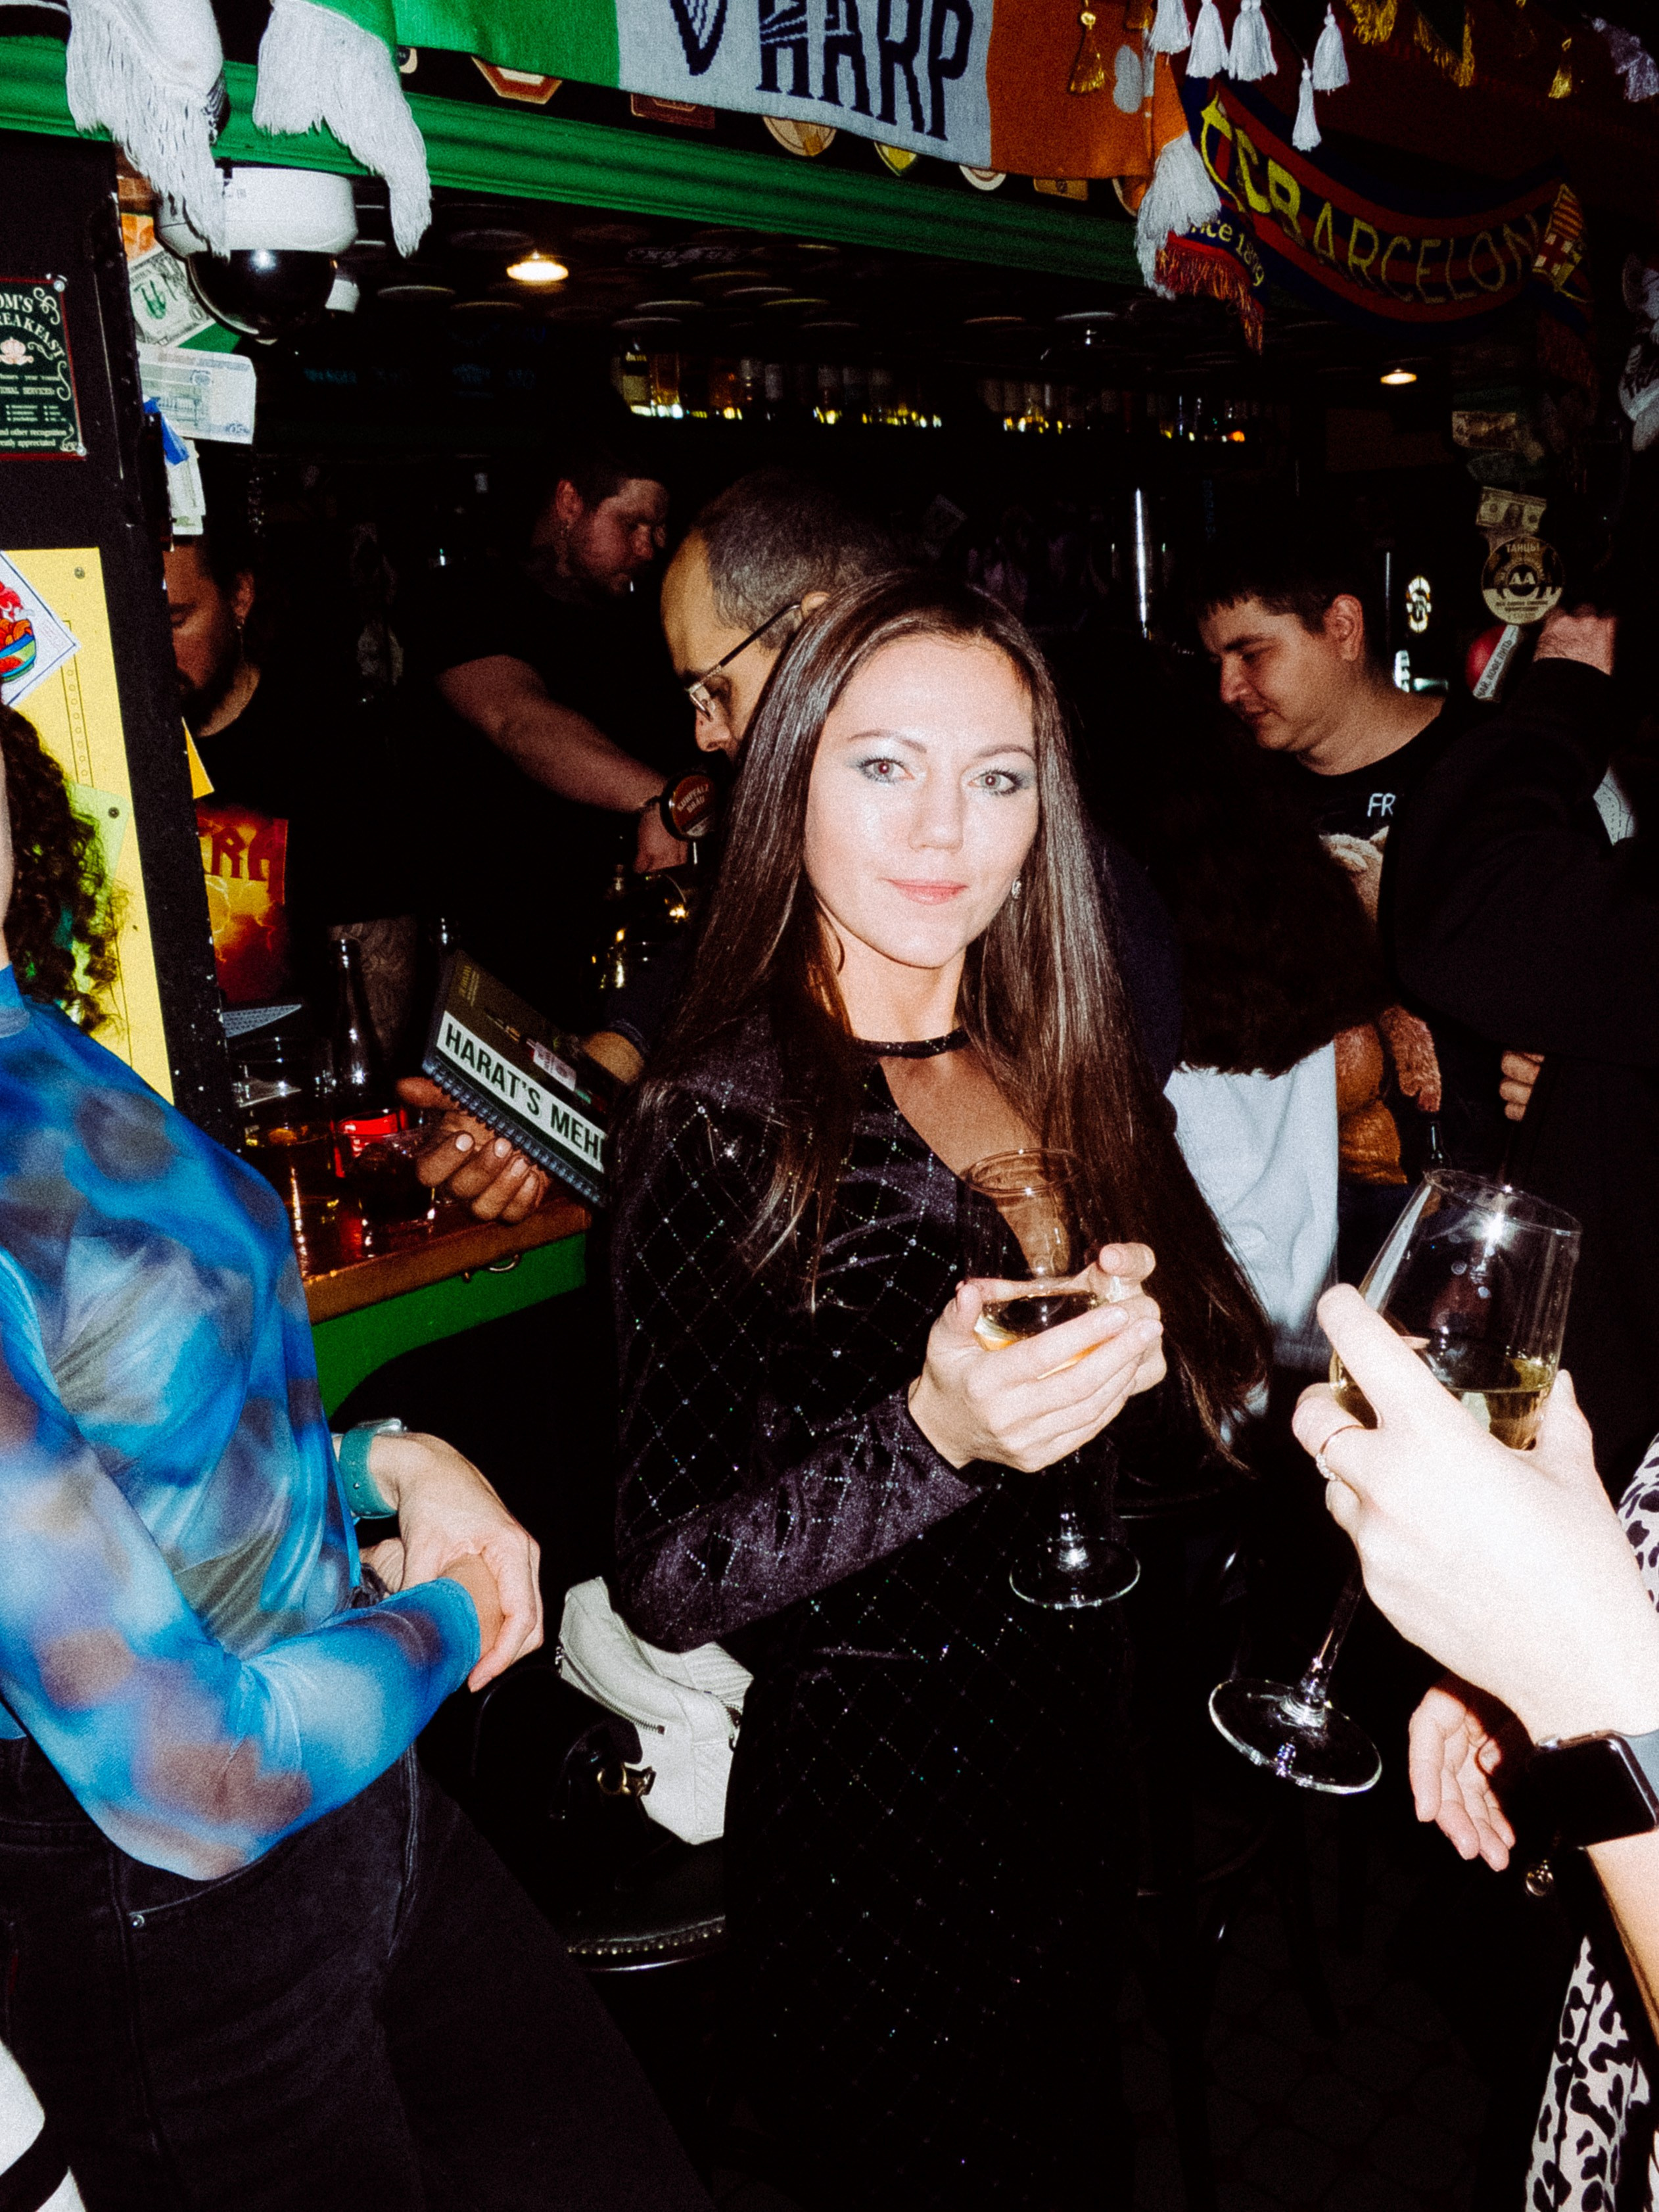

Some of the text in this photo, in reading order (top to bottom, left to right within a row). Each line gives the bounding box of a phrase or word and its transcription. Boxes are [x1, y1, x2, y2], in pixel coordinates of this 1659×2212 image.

[756, 0, 973, 141] HARP
[1505, 543, 1540, 553] ТАНЦЫ
[445, 1023, 542, 1117] HARAT'S
